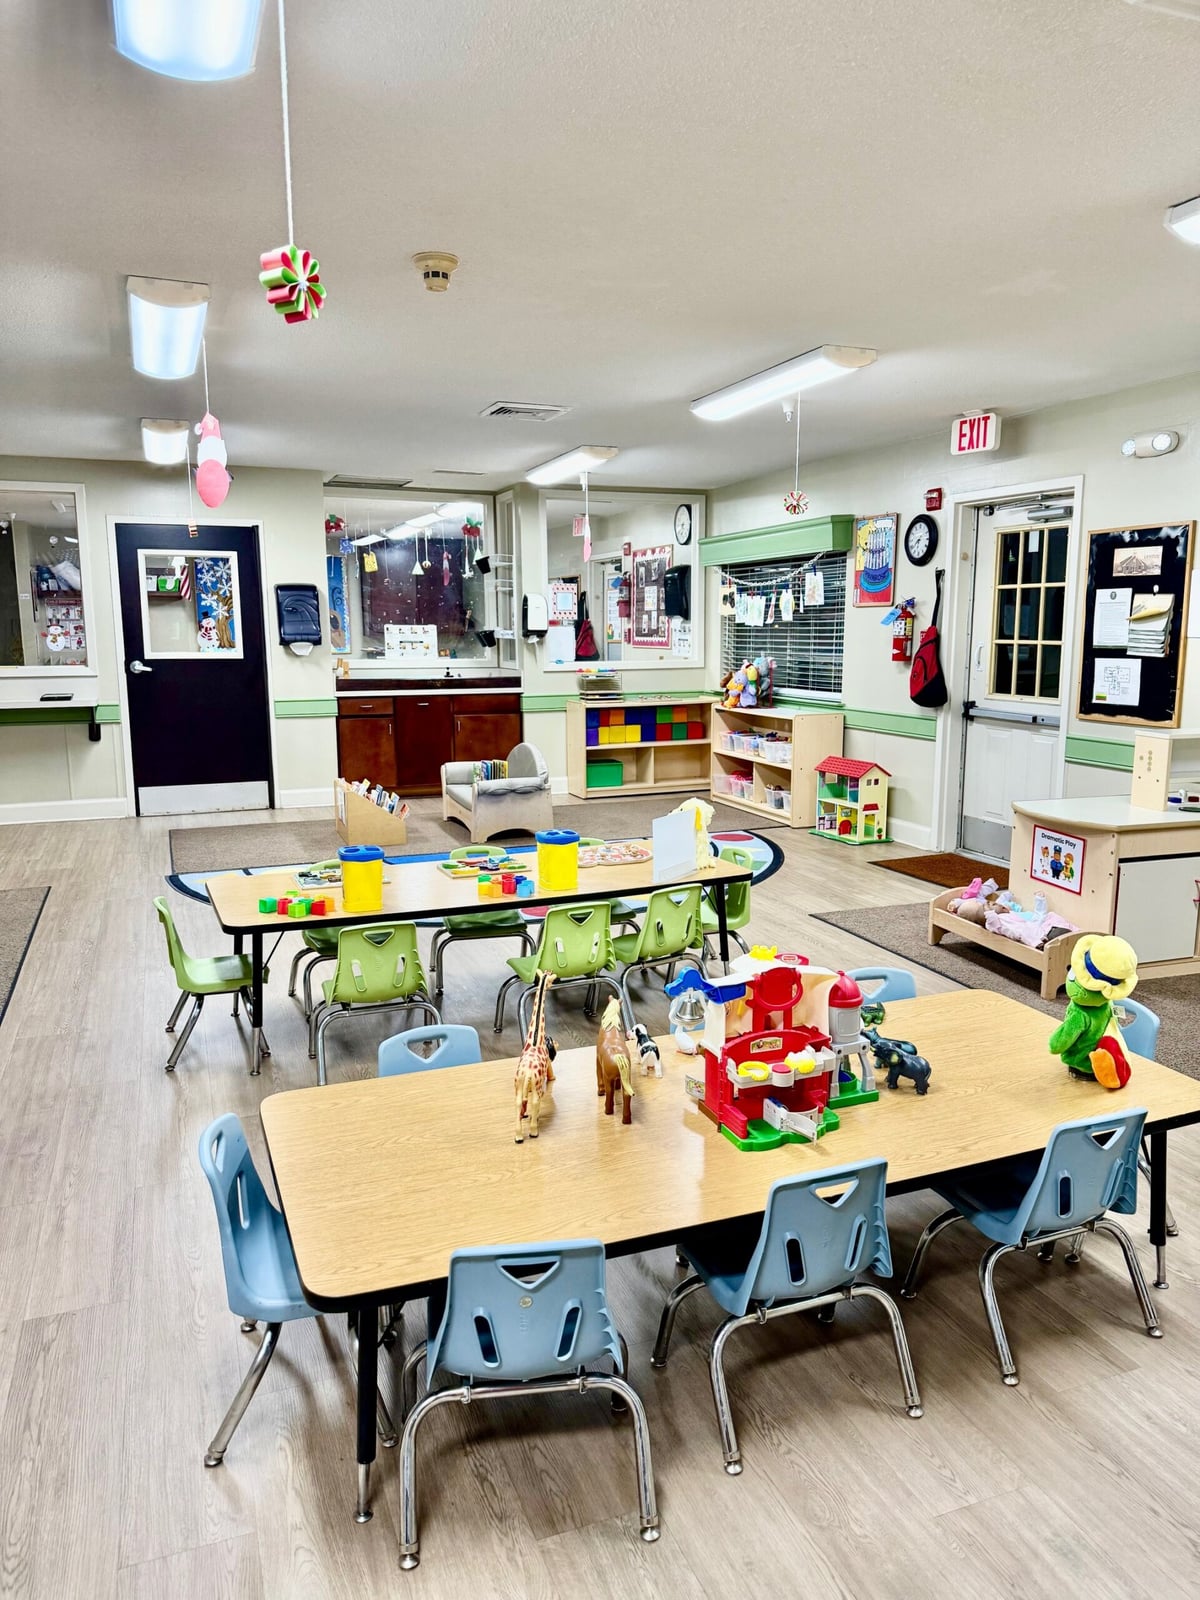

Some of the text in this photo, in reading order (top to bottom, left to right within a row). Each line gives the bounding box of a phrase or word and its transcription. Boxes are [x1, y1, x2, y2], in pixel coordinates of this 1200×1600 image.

[958, 415, 991, 452] EXIT
[1041, 832, 1077, 850] Dramatic Play
